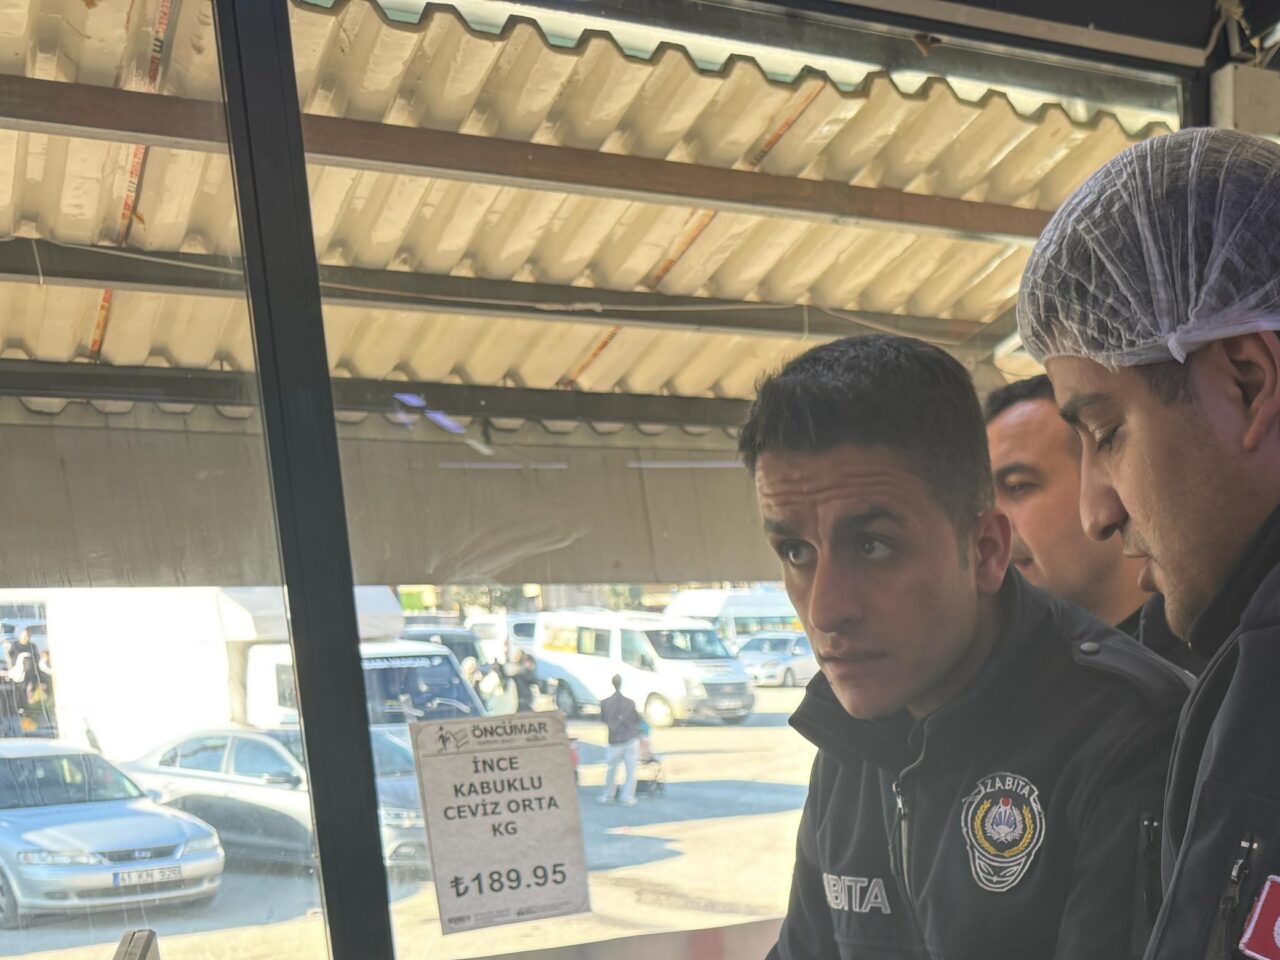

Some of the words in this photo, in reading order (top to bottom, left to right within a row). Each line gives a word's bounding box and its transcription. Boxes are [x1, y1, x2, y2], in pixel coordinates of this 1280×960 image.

[472, 720, 548, 739] ÖNCÜMAR
[472, 755, 520, 774] İNCE
[453, 776, 543, 798] KABUKLU
[985, 776, 1030, 798] ZABITA
[443, 801, 501, 820] CEVİZ
[507, 796, 559, 814] ORTA
[491, 821, 518, 838] KG
[823, 873, 891, 914] BITA
